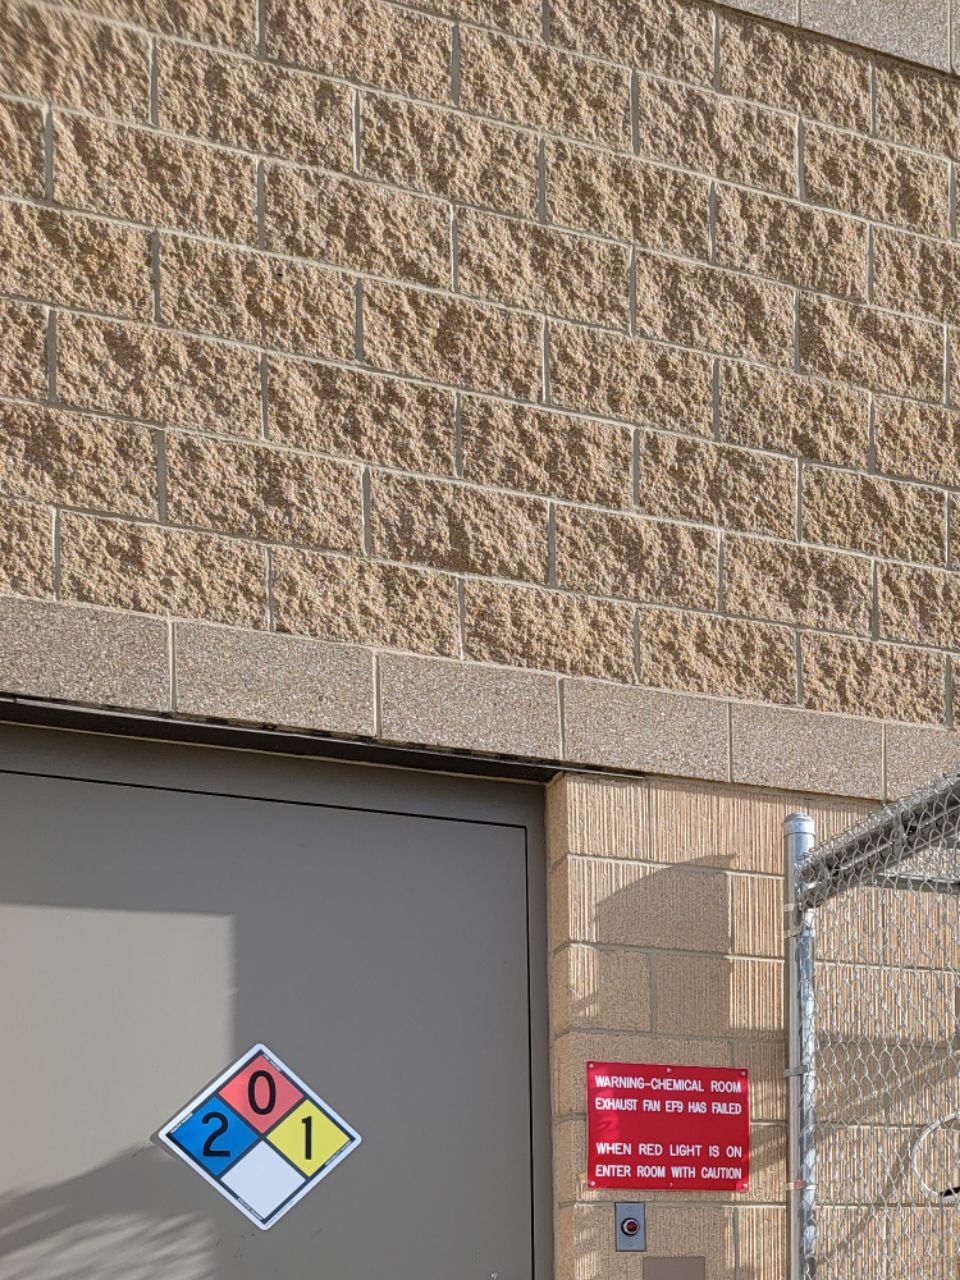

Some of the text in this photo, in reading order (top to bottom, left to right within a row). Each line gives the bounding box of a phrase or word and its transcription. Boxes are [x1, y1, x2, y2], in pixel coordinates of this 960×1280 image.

[248, 1070, 276, 1115] 0
[595, 1075, 741, 1093] WARNING-CHEMICAL ROOM
[595, 1097, 741, 1115] EXHAUST FAN EF9 HAS FAILED
[201, 1111, 231, 1158] 2
[301, 1115, 312, 1160] 1
[596, 1143, 742, 1158] WHEN RED LIGHT IS ON
[595, 1165, 741, 1179] ENTER ROOM WITH CAUTION
